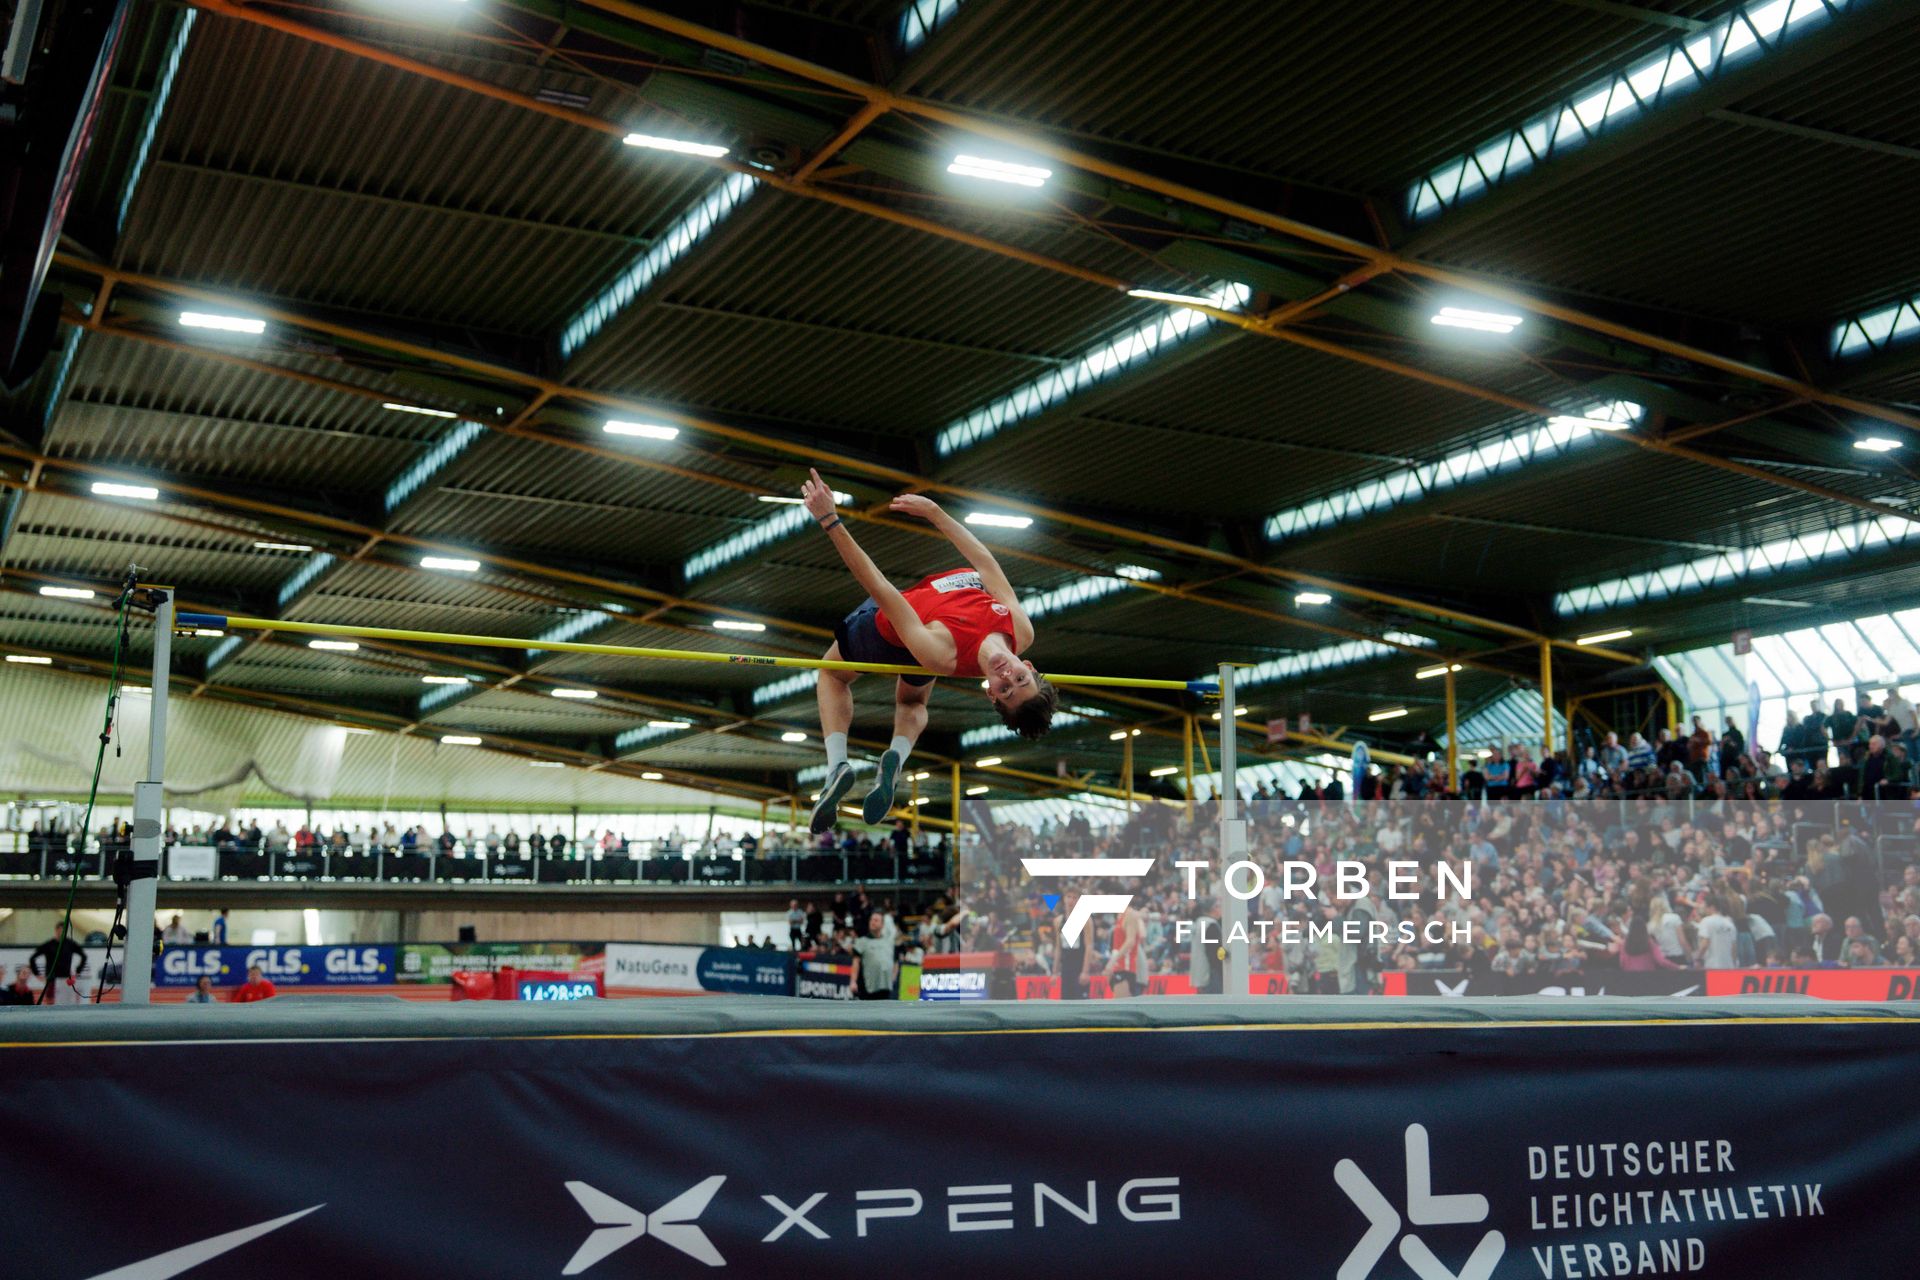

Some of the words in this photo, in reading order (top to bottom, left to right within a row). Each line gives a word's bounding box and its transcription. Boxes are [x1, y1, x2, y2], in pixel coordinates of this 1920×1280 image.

[615, 959, 688, 976] NatuGena
[800, 980, 855, 1000] SPORTLA
[1527, 1139, 1735, 1180] DEUTSCHER
[760, 1176, 1180, 1242] XPENG
[1530, 1184, 1825, 1230] LEICHTATHLETIK
[1532, 1238, 1705, 1280] VERBAND
